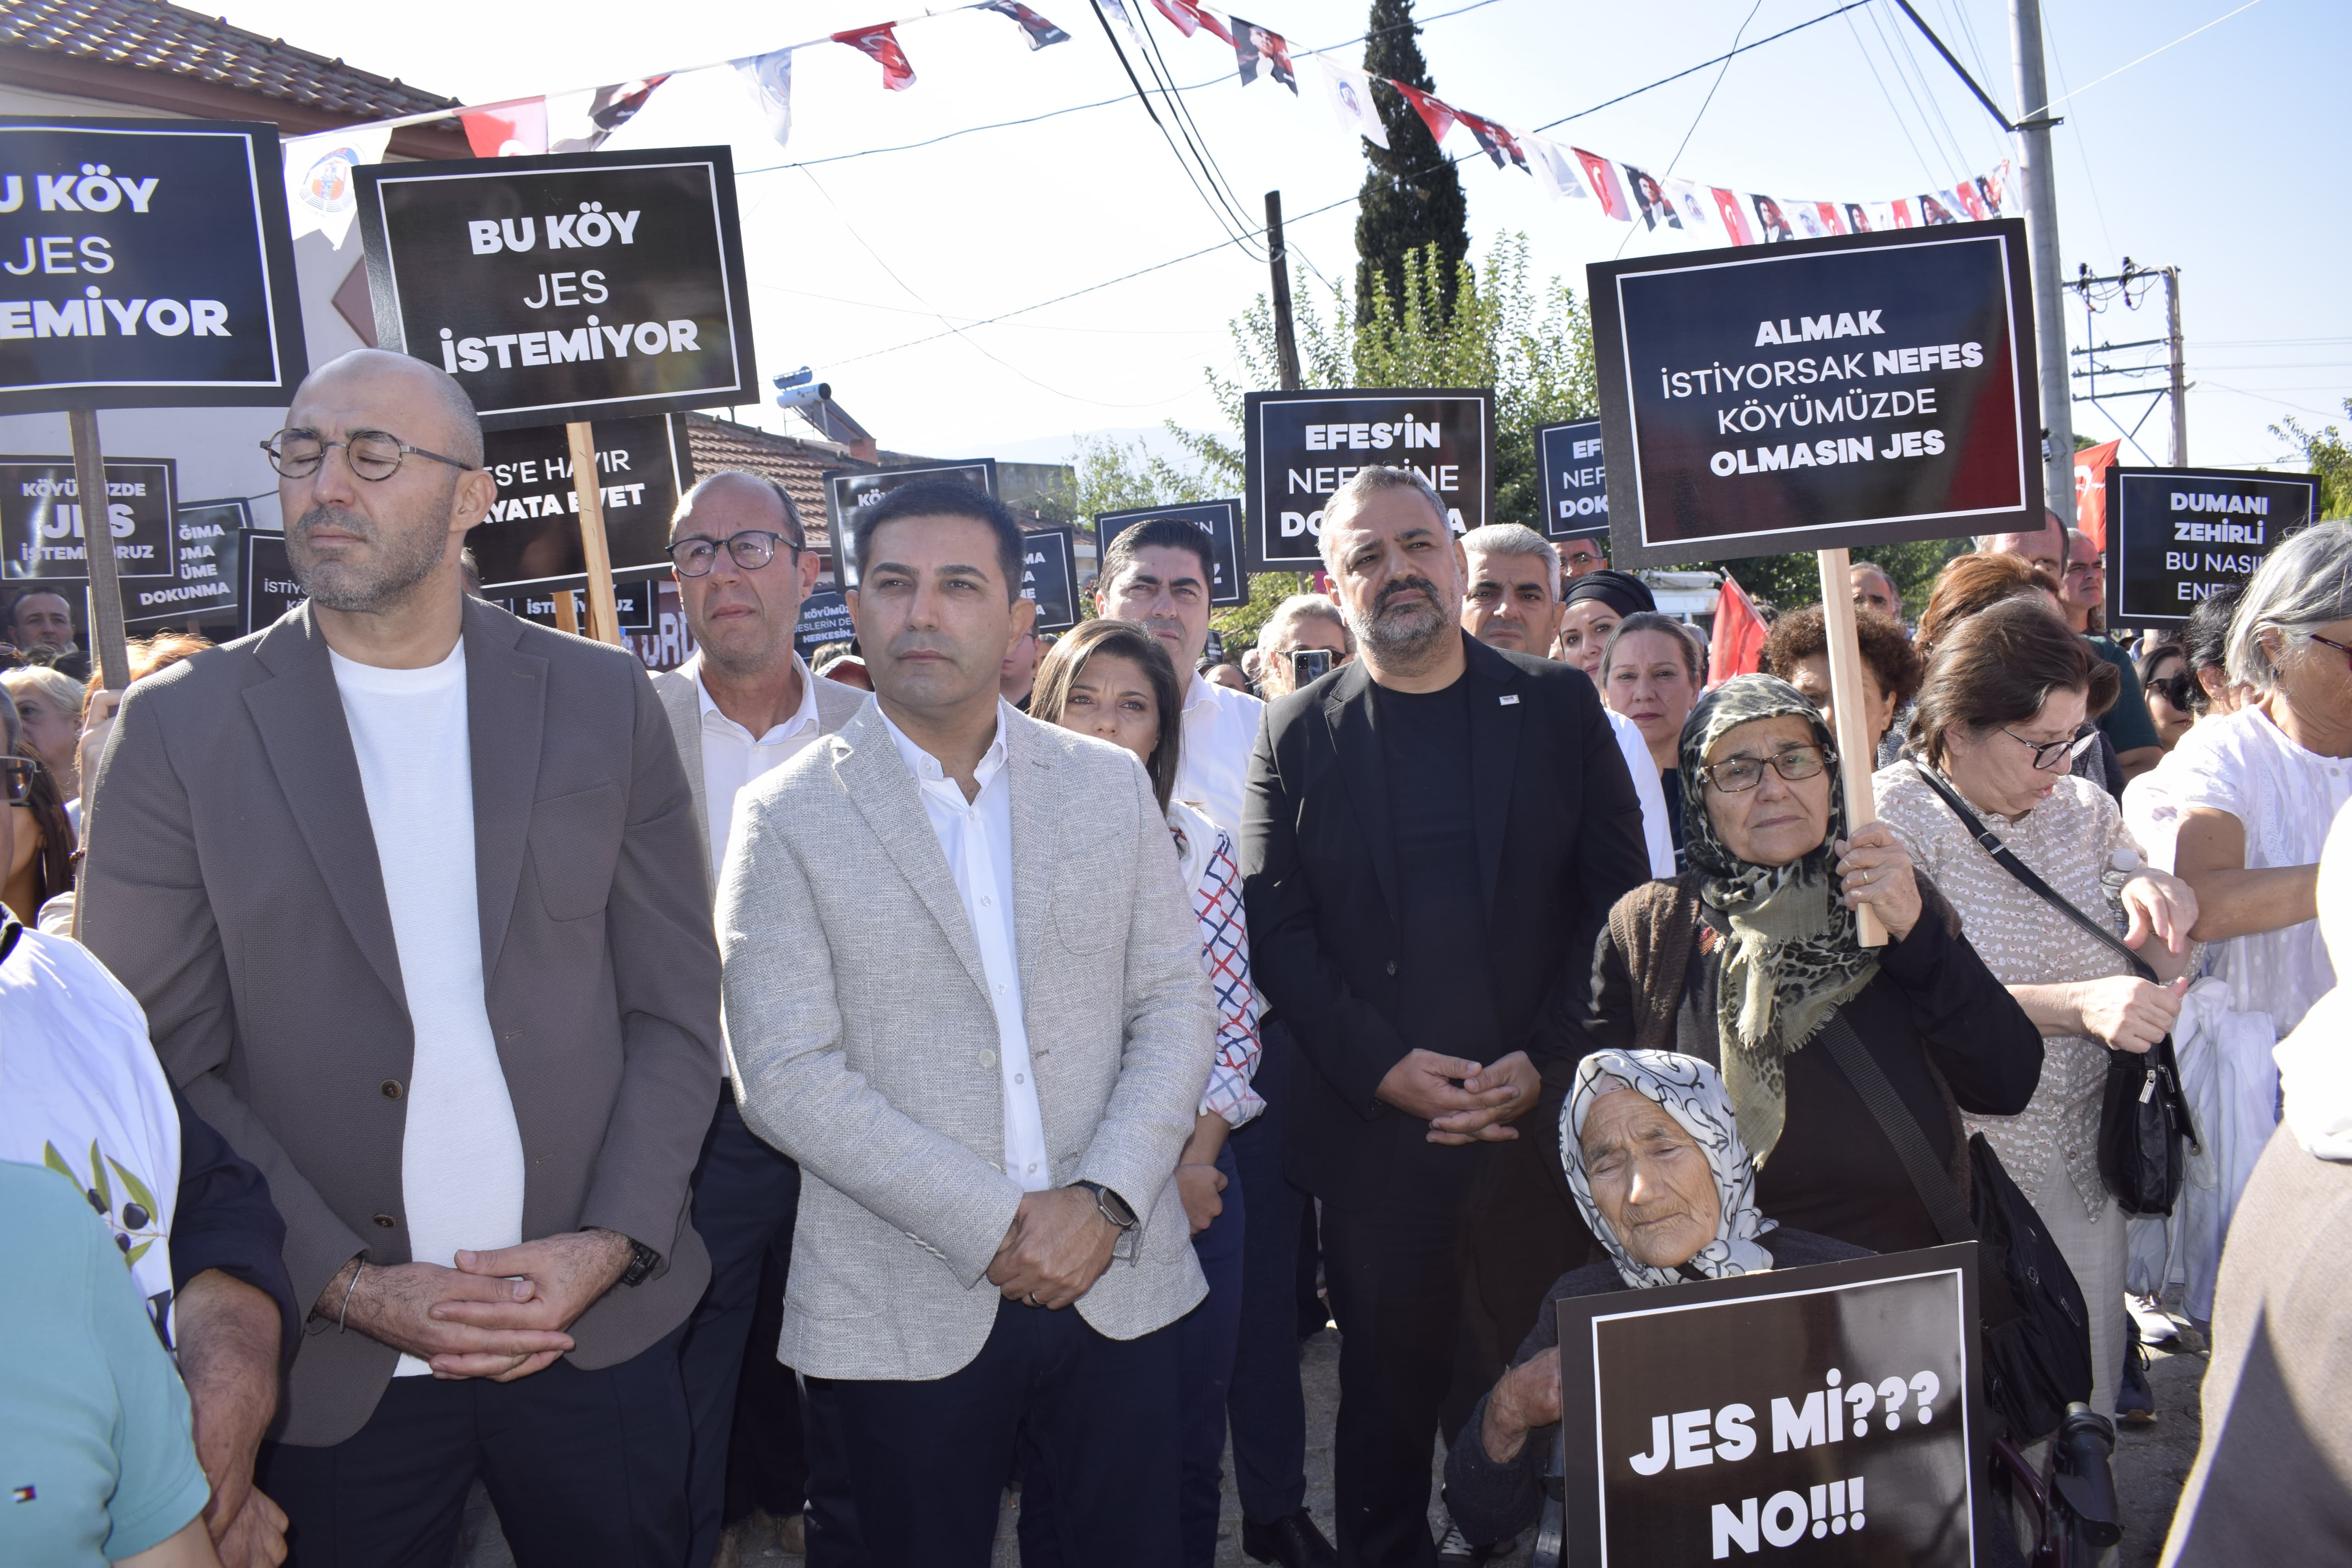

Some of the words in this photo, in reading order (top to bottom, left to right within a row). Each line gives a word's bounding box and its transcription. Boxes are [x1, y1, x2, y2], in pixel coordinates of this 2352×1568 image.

[37, 164, 159, 212] KÖY
[469, 217, 535, 255] BU
[545, 201, 641, 249] KÖY
[4, 237, 114, 275] JES
[524, 270, 609, 308] JES
[0, 286, 232, 339] EMİYOR
[1755, 310, 1885, 347] ALMAK
[440, 315, 701, 374] İSTEMİYOR
[1662, 353, 1865, 399] İSTİYORSAK
[1873, 342, 1983, 376] NEFES
[1718, 389, 1936, 434] KÖYÜMÜZDE
[1710, 436, 1874, 477] OLMASIN
[1881, 430, 1945, 459] JES
[2171, 492, 2268, 515] DUMANI
[179, 524, 225, 540] ĞIMA
[2174, 518, 2264, 544] ZEHİRLİ
[181, 563, 218, 579] ÜME
[2166, 552, 2198, 571] BU
[140, 582, 231, 606] DOKUNMA
[265, 578, 309, 596] İSTİY
[1629, 1404, 1756, 1476] JES
[1771, 1368, 1940, 1453] Mİ???
[1712, 1477, 1865, 1559] NO!!!
